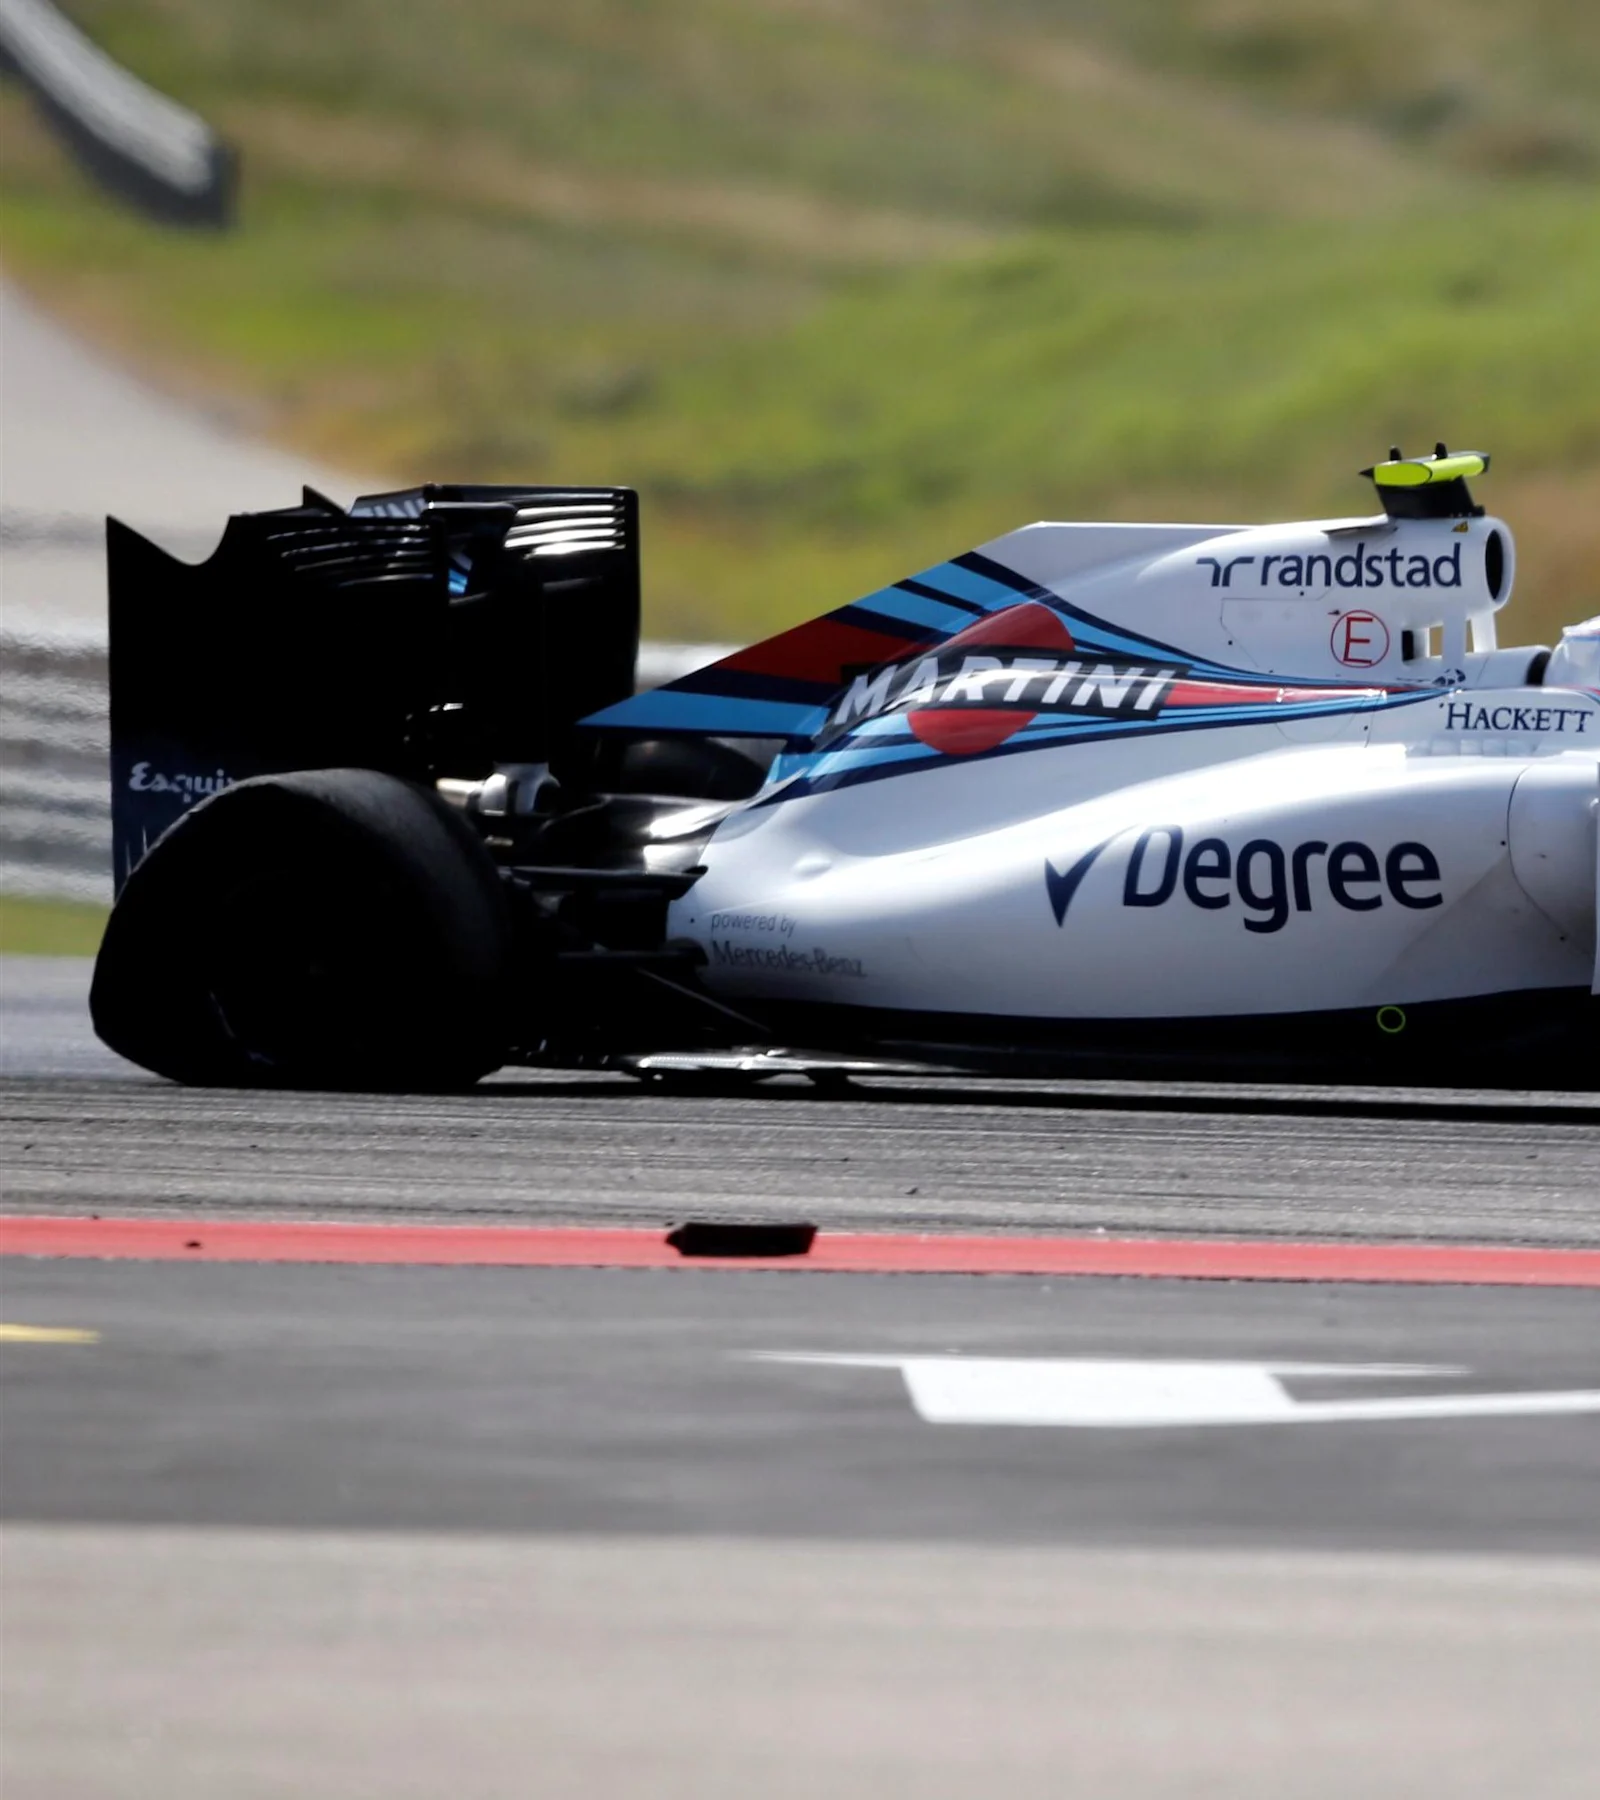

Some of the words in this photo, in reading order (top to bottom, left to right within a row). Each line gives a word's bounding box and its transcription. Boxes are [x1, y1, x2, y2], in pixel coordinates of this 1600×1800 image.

[1260, 542, 1462, 588] randstad
[1342, 616, 1374, 664] E
[834, 655, 1176, 726] MARTINI
[1445, 702, 1594, 733] HACKETT
[129, 761, 235, 803] Esqui
[1122, 823, 1444, 934] Degree
[711, 913, 777, 933] powered
[781, 913, 798, 938] by
[711, 940, 869, 978] Mercedes-Benz
